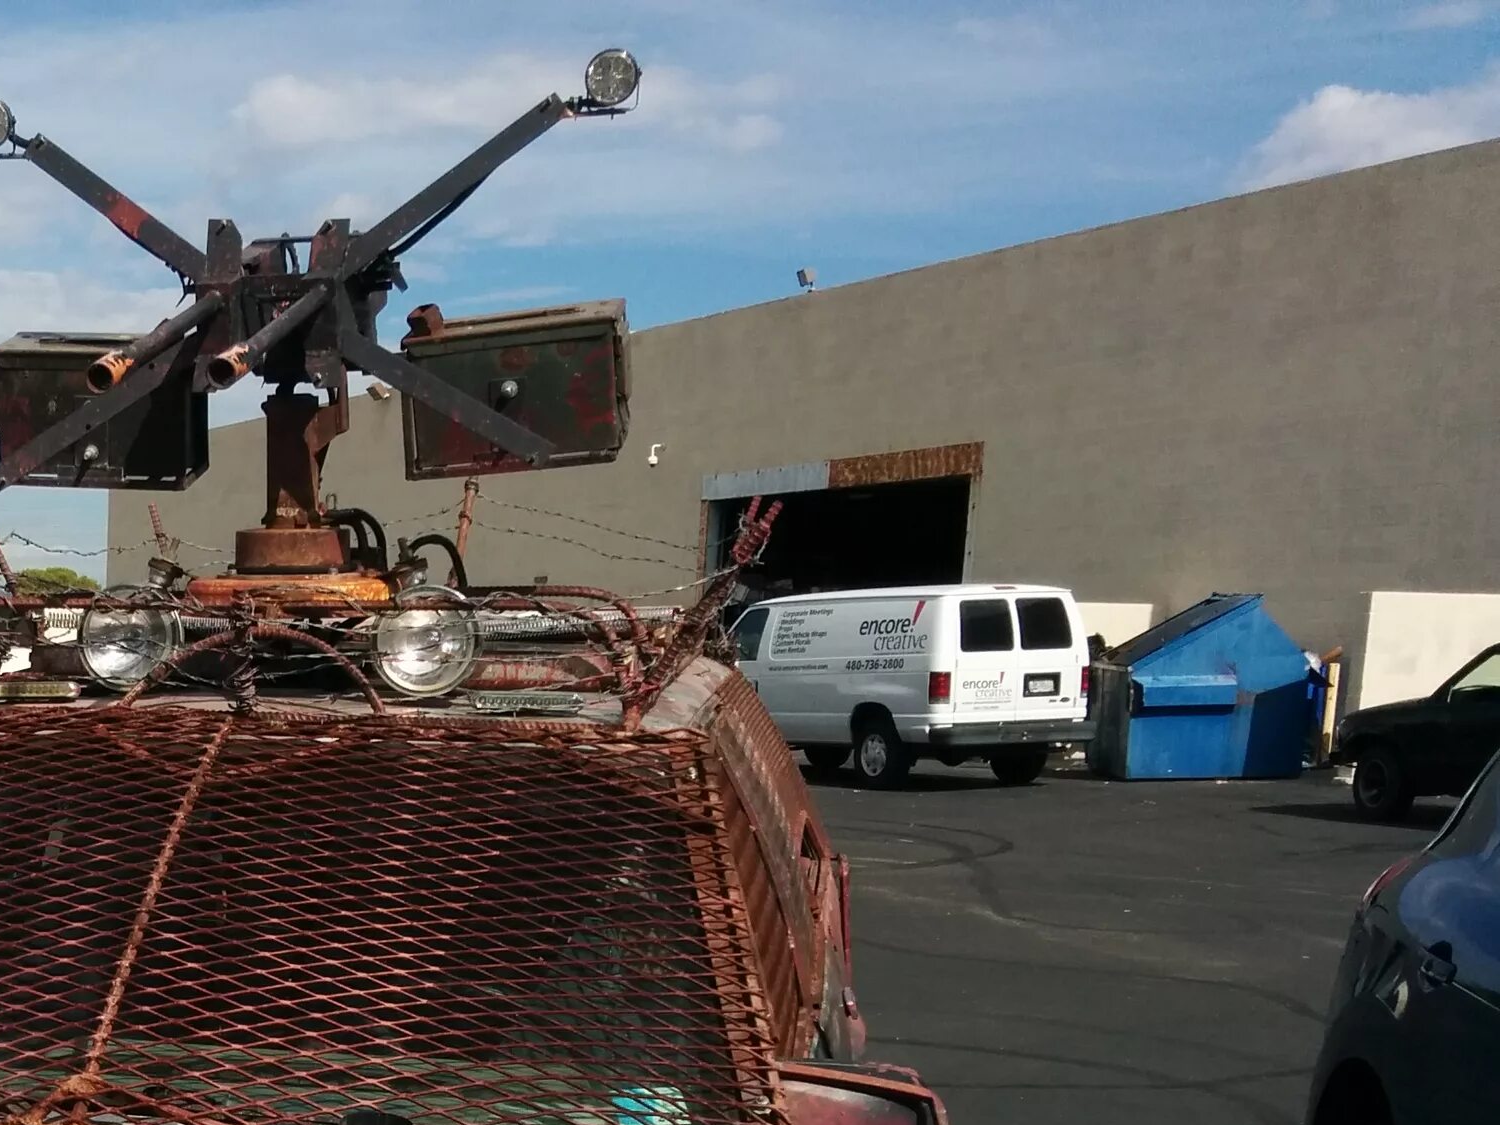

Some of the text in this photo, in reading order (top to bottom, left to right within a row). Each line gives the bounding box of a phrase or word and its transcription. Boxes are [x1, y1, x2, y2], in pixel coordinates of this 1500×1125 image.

[873, 633, 928, 651] creative
[845, 658, 905, 670] 480-736-2800
[975, 687, 1013, 698] creative
